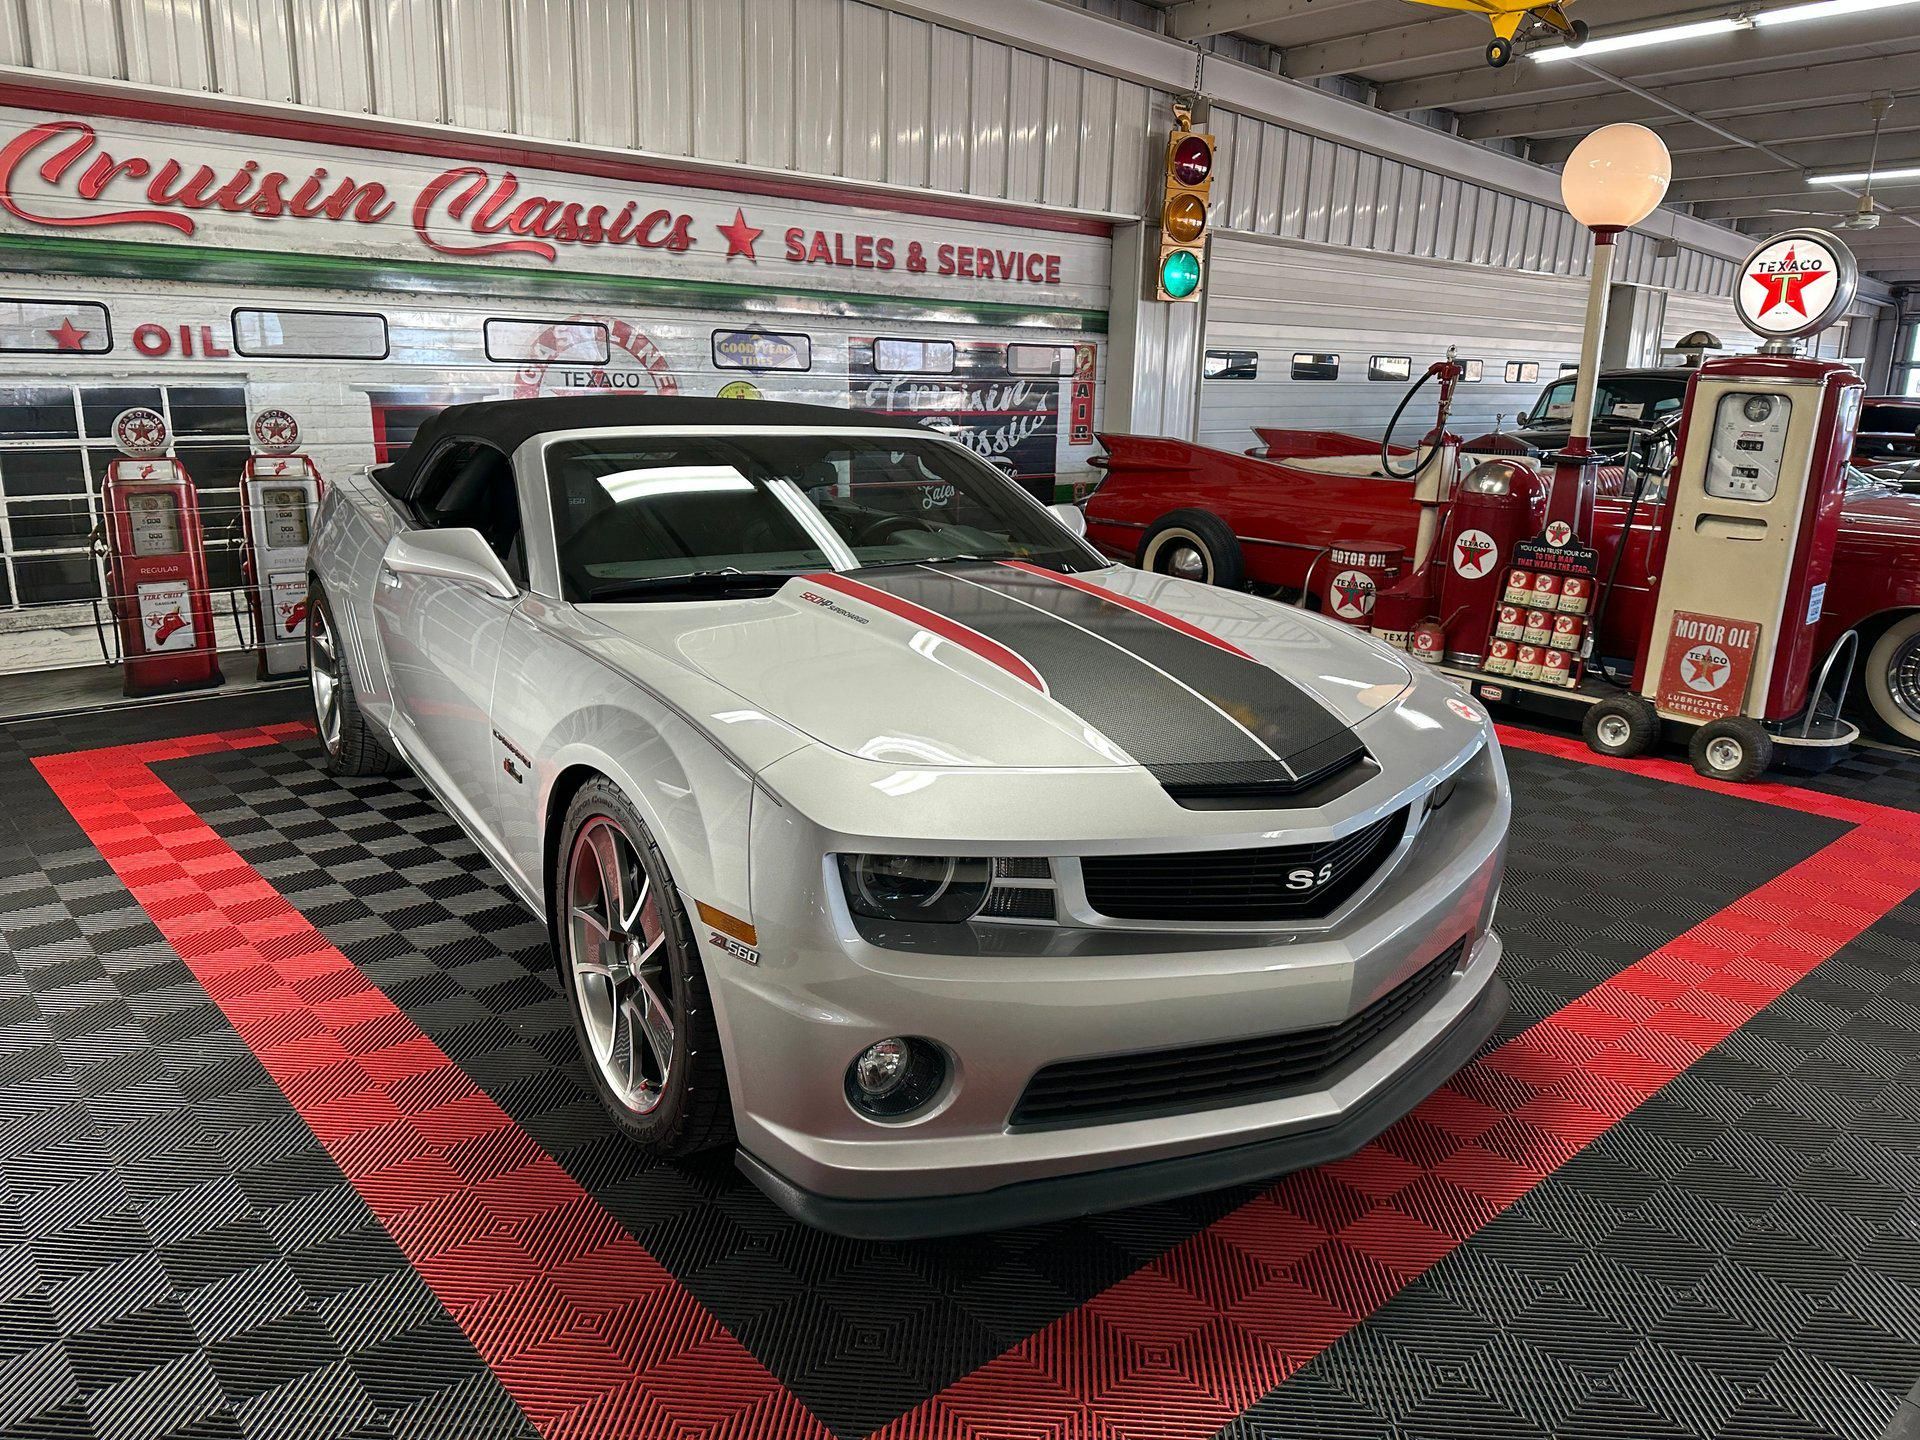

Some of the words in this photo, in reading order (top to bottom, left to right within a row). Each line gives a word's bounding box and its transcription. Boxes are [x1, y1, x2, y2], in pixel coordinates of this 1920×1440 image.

[0, 121, 395, 235] Cruisin
[413, 166, 695, 261] Classics
[785, 227, 895, 270] SALES
[906, 240, 928, 273] &
[938, 244, 1061, 284] SERVICE
[1758, 259, 1822, 273] TEXACO
[133, 323, 229, 358] OIL
[560, 371, 640, 389] TEXACO
[1076, 382, 1090, 439] AIR
[1459, 538, 1491, 549] TEXACO
[1520, 544, 1531, 552] YOU
[1547, 547, 1562, 555] TRUST
[1563, 549, 1579, 557] YOUR
[1580, 551, 1592, 559] CAR
[1331, 549, 1366, 567] MOTOR
[1369, 554, 1386, 568] OIL
[140, 565, 179, 575] REGULAR
[1336, 578, 1373, 590] TEXACO
[1676, 619, 1725, 644] MOTOR
[1728, 627, 1750, 648] OIL
[1689, 652, 1728, 665] TEXACO
[1667, 693, 1729, 711] LUBRICATES
[1668, 701, 1724, 719] PERFECTLY
[1285, 862, 1333, 890] SS
